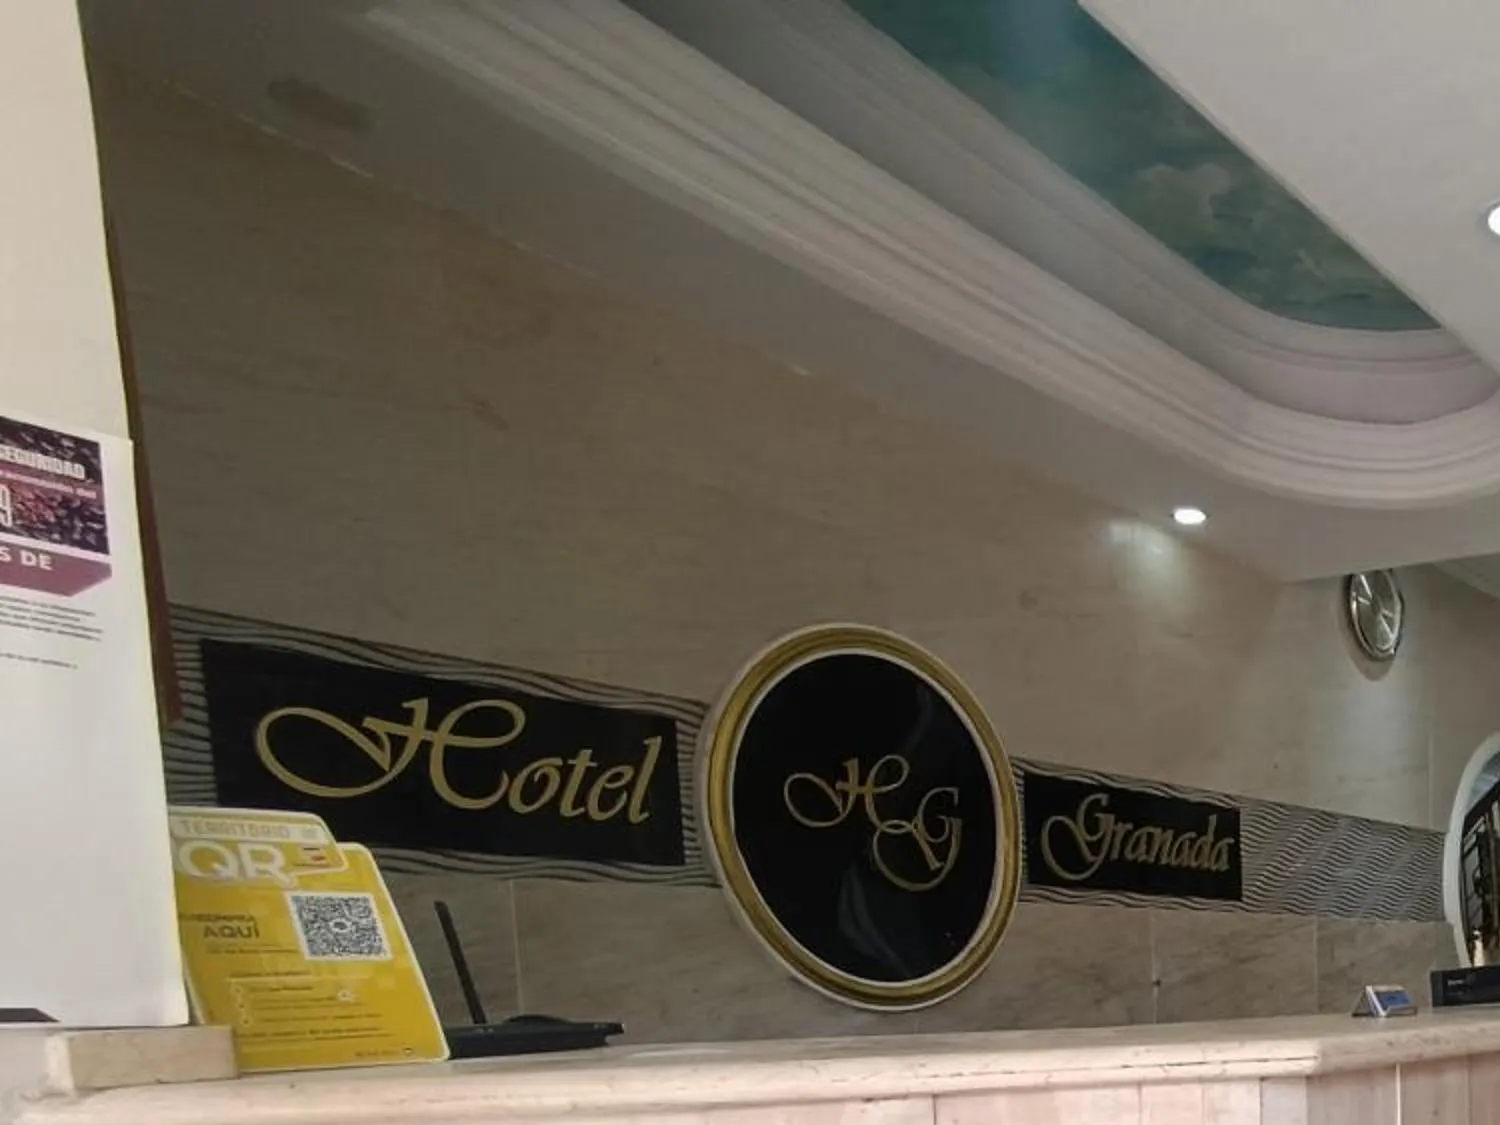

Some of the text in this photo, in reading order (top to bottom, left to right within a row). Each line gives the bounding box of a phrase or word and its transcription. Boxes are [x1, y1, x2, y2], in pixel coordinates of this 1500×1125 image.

[20, 551, 53, 571] DE
[255, 697, 663, 825] Hotel
[1040, 793, 1236, 881] Granada
[178, 838, 298, 888] QR
[203, 920, 260, 939] AQUÍ
